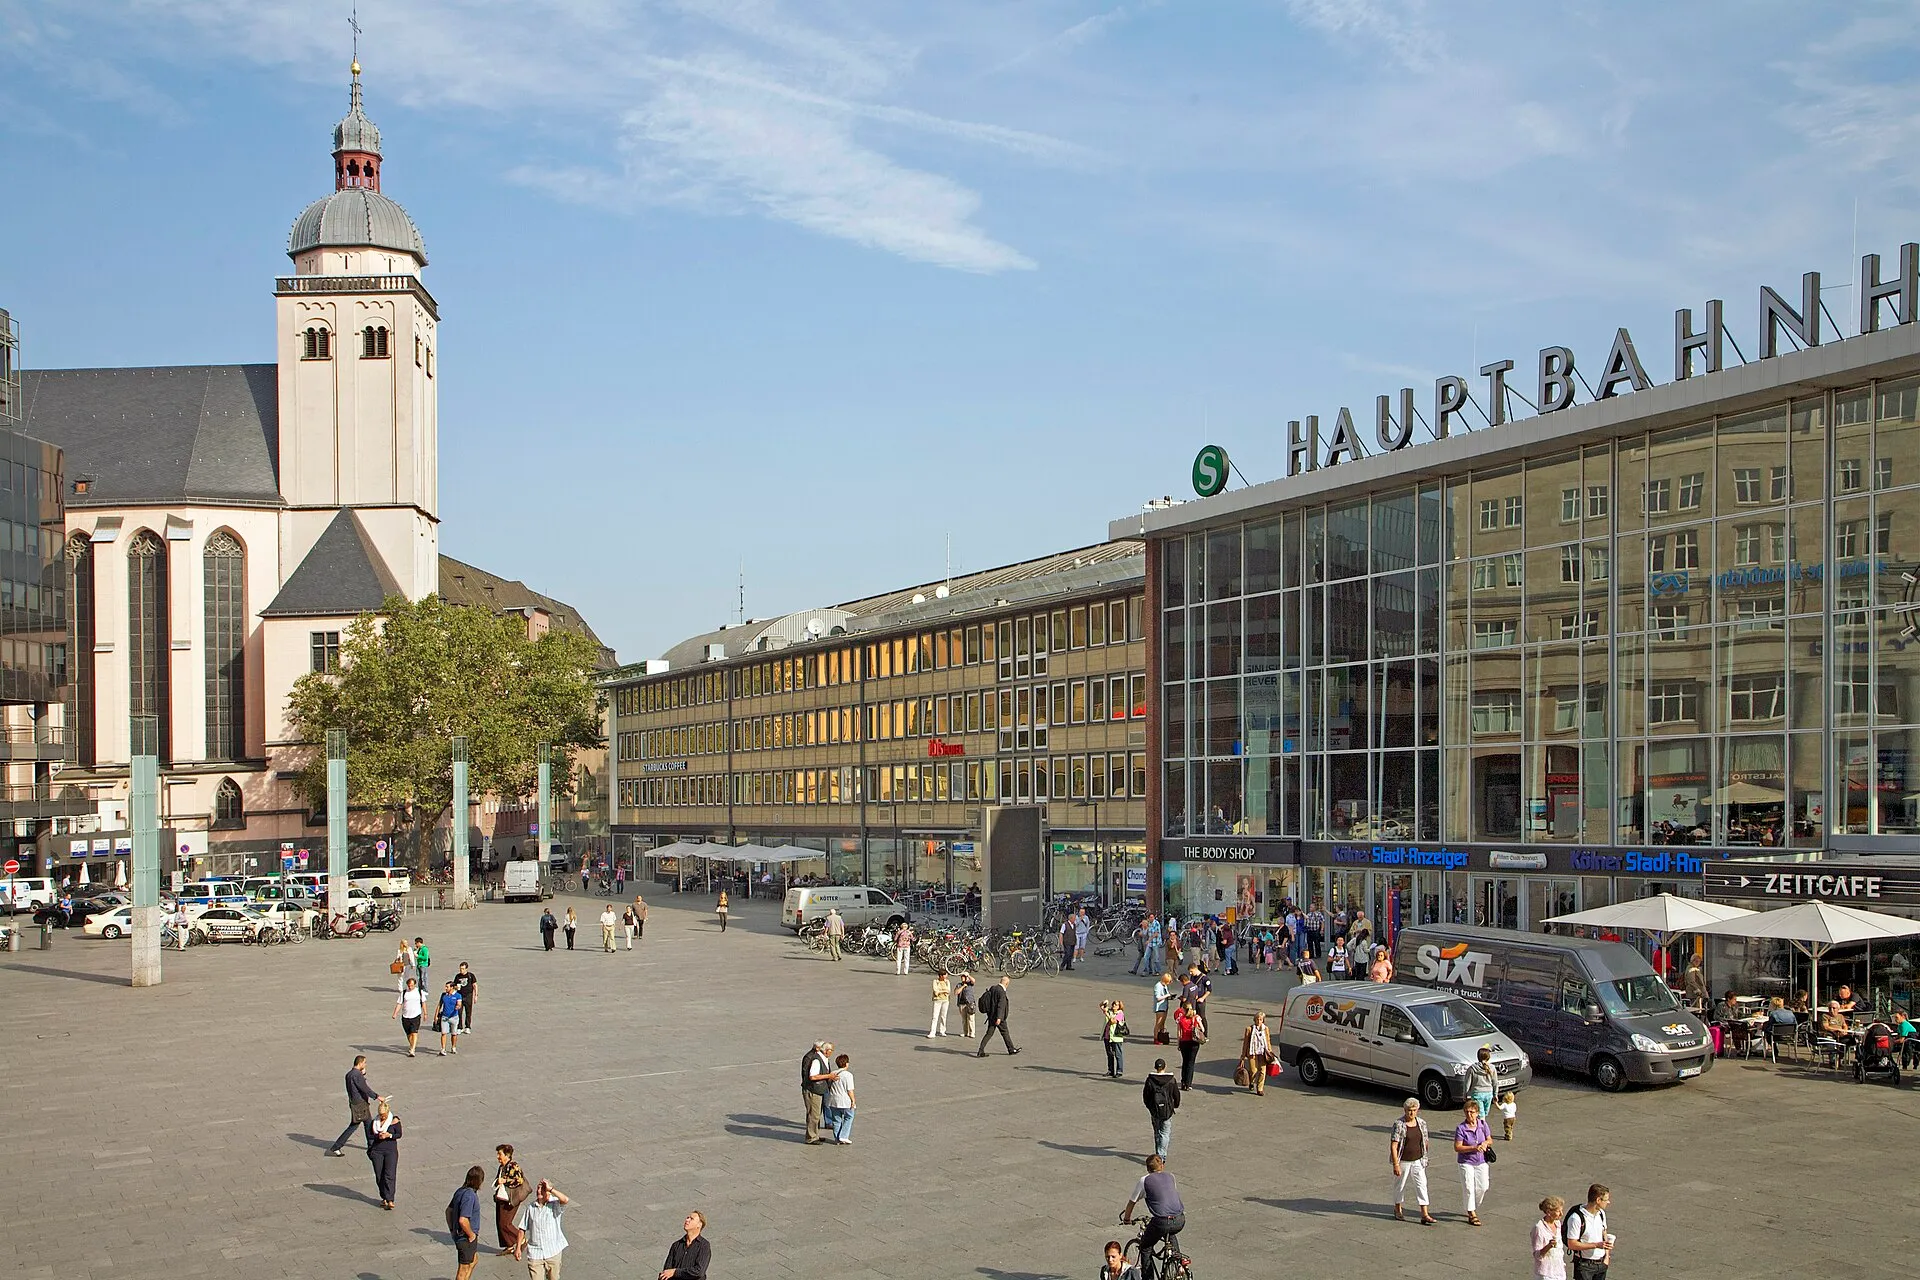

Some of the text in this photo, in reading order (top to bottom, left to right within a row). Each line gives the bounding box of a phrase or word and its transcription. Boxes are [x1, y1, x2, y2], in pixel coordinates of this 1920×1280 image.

[1286, 242, 1920, 477] HAUPTBAHNH
[1199, 452, 1217, 490] S
[642, 761, 687, 771] STARBUCKS COFFEE
[1183, 846, 1255, 860] THE BODY SHOP
[1371, 846, 1469, 870] Stadt-Anzeiger
[1569, 850, 1703, 873] Kölner Stadt-An
[1127, 869, 1147, 883] Chang
[1460, 989, 1482, 999] truck
[1677, 1040, 1696, 1048] IVECO
